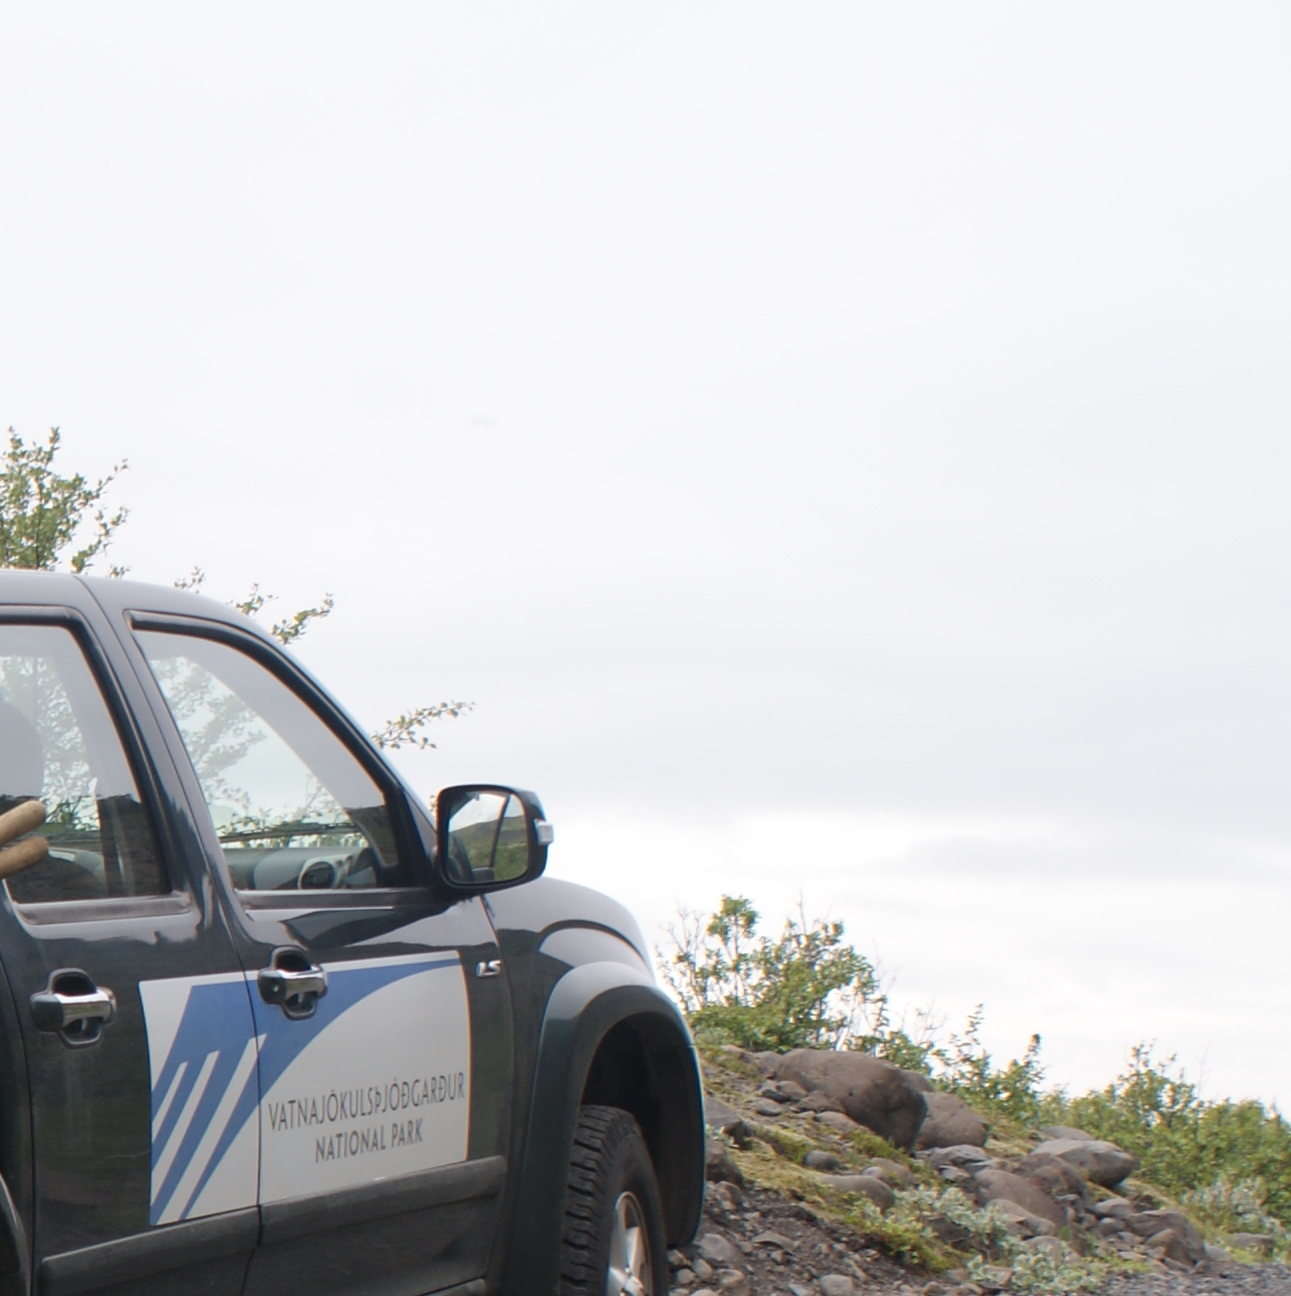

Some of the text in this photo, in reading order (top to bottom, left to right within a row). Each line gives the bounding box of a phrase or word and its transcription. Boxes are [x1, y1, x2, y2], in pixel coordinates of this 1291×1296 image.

[268, 1072, 465, 1131] VATNAJÖKULSÞJÓÐGARÐUR
[315, 1118, 424, 1164] NATIONAL PARK
